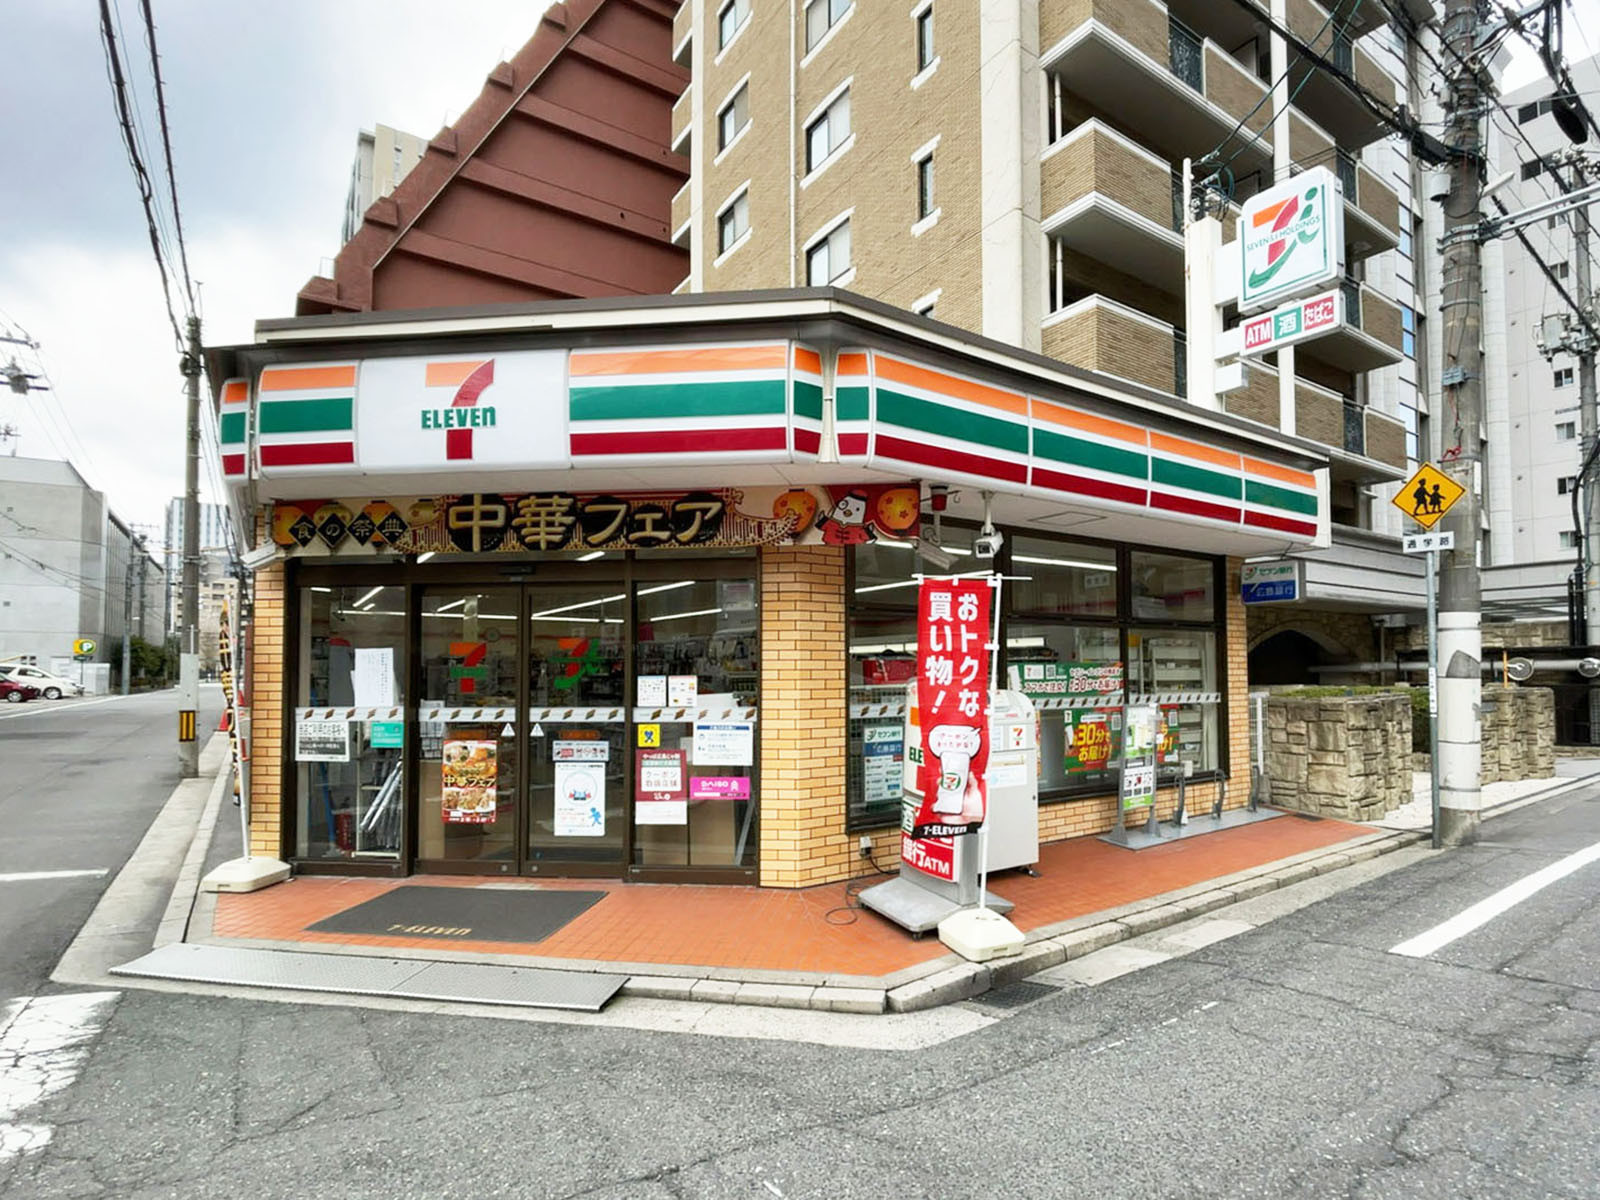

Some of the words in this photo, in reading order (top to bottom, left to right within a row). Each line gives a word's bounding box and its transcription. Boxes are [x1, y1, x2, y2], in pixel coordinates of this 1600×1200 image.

[1279, 215, 1321, 237] HOLDINGS
[1278, 311, 1297, 336] 酒
[1304, 300, 1334, 325] たばこ
[1246, 319, 1272, 345] ATM
[294, 517, 404, 539] 食の祭典
[449, 493, 723, 553] 中華フェア
[958, 592, 980, 718] おトクな
